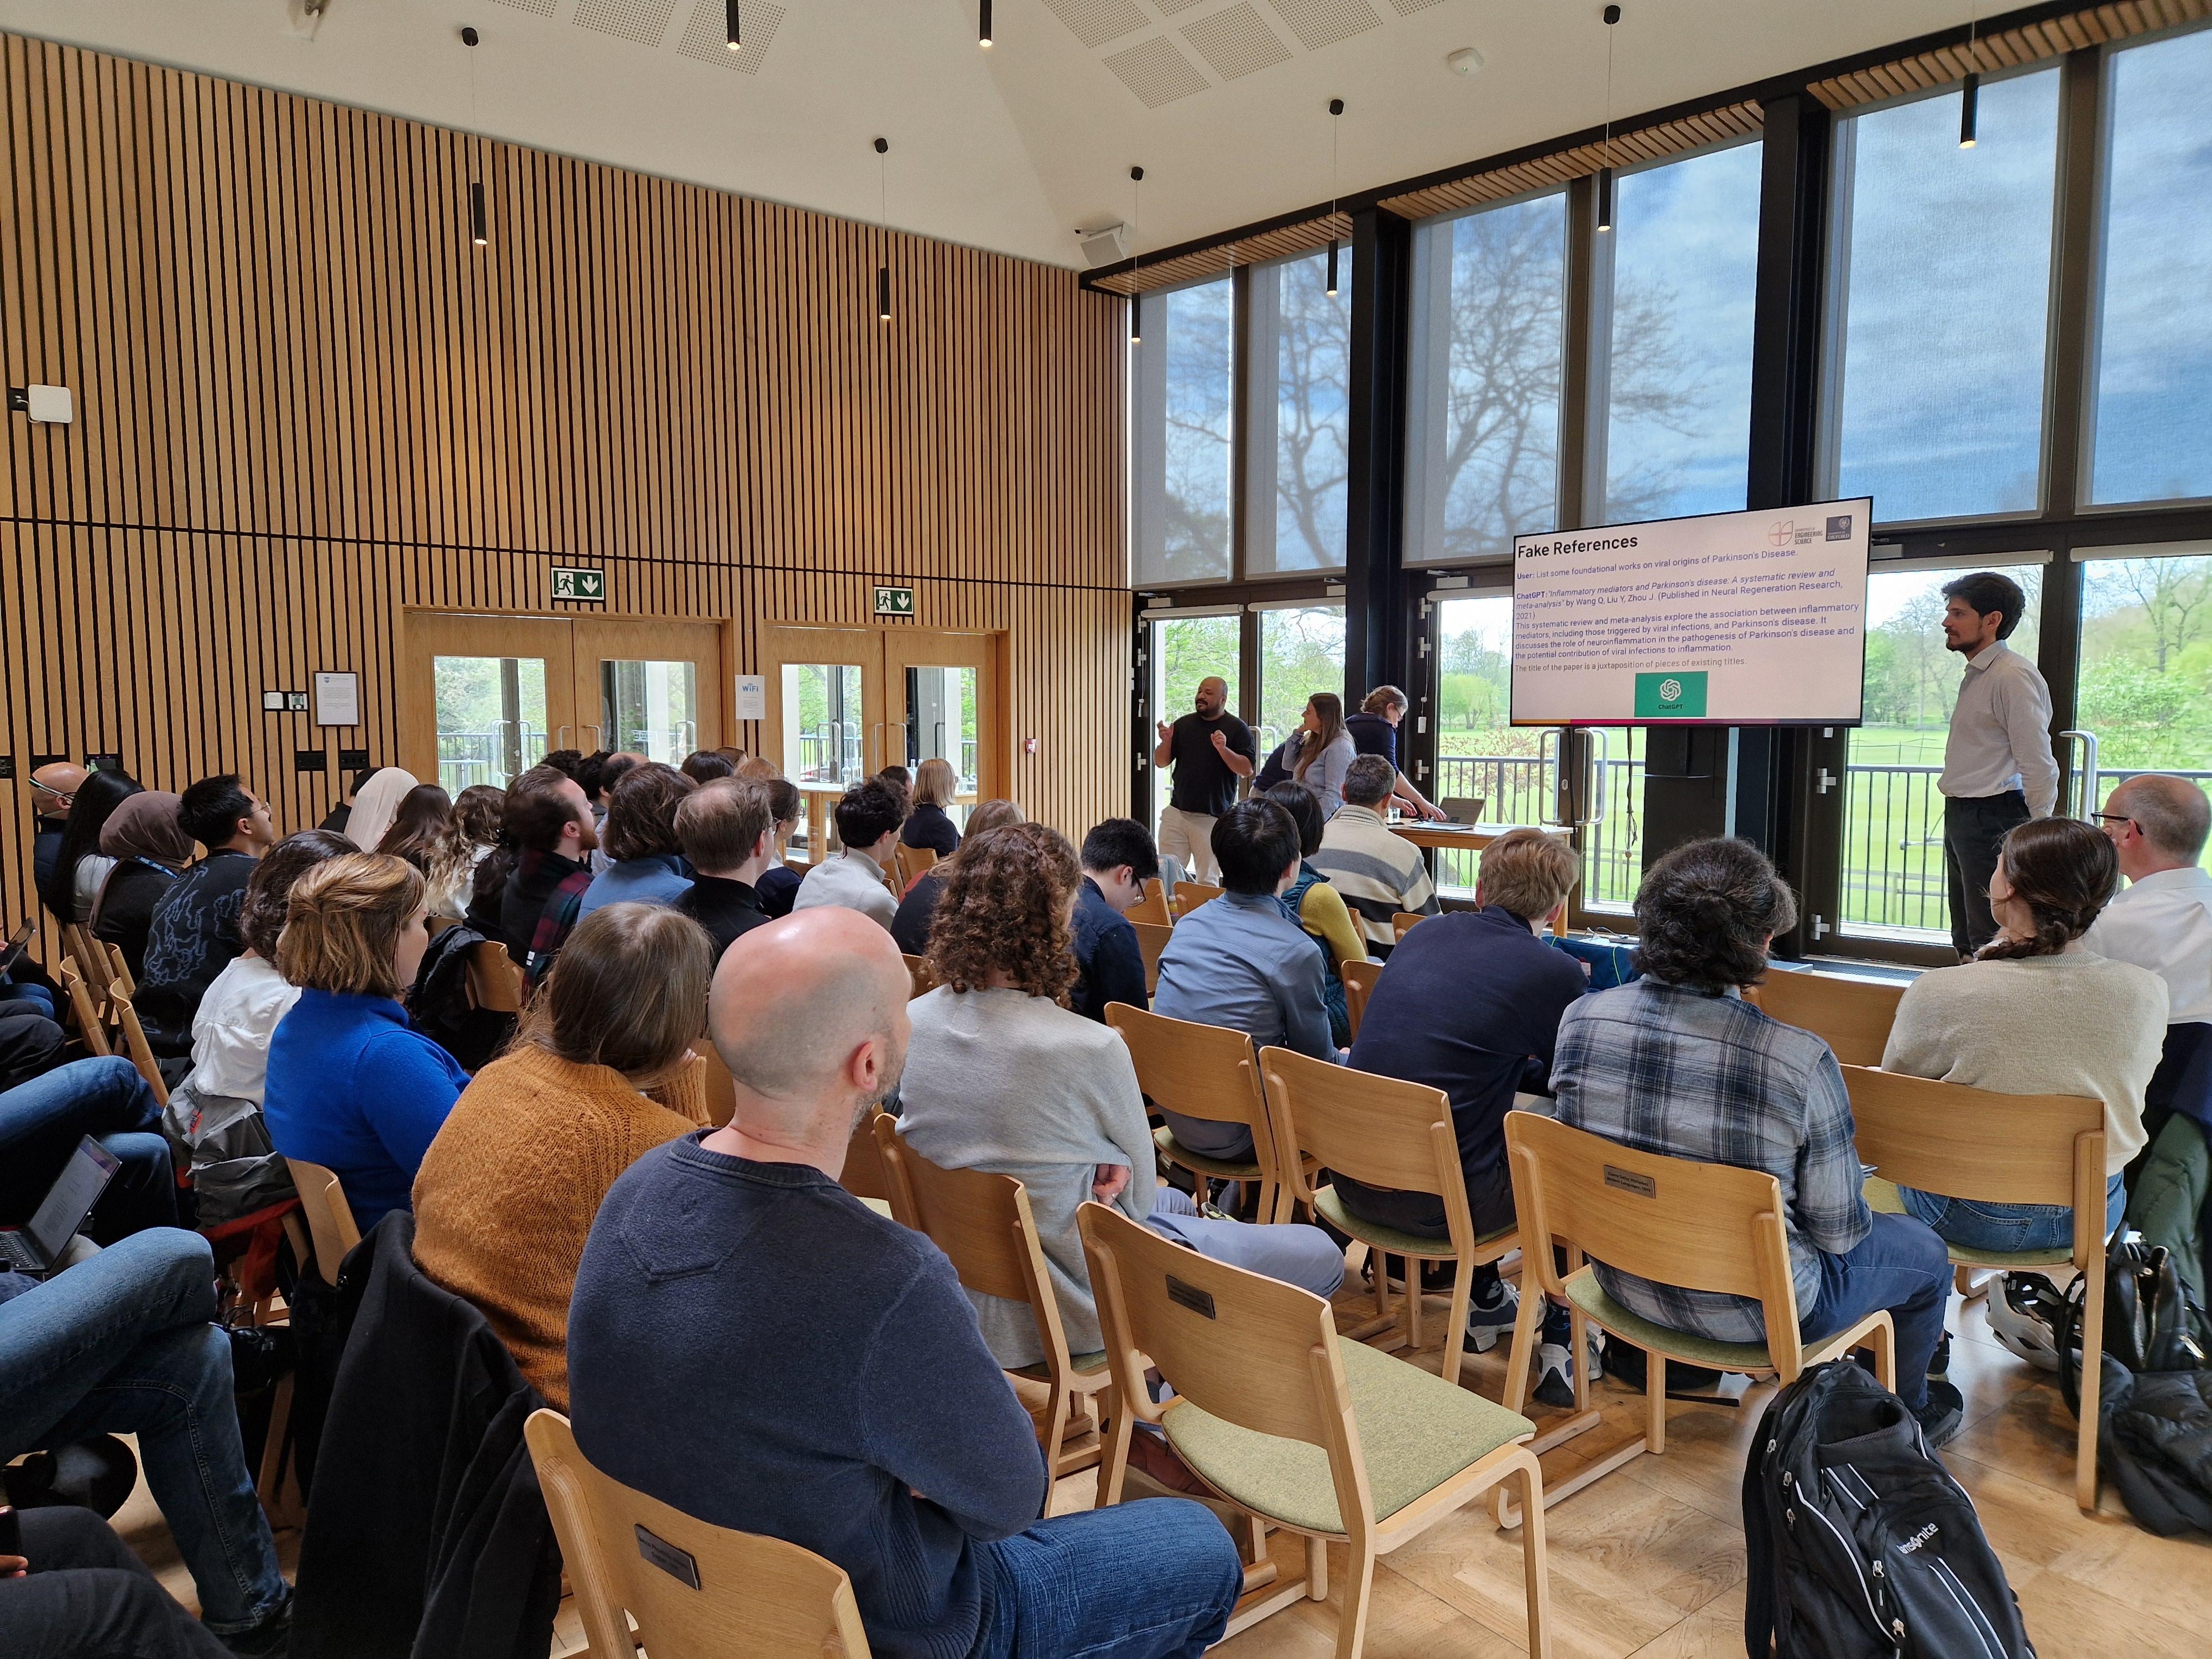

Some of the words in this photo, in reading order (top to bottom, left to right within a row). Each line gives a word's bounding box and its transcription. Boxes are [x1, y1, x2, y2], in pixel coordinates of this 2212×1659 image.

[1519, 544, 1549, 559] Fake
[1554, 536, 1637, 555] References
[1572, 564, 1616, 575] foundational
[1619, 562, 1640, 570] works
[1655, 559, 1670, 567] viral
[1673, 557, 1699, 567] origins
[1702, 555, 1709, 564] of
[1713, 551, 1759, 562] Parkinson's
[1762, 550, 1797, 559] Disease.
[1517, 591, 1547, 599] ChatGPT:
[1651, 580, 1694, 589] Parkinson's
[1740, 573, 1785, 584] systematic
[1788, 571, 1815, 579] review
[1818, 568, 1835, 577] and
[1620, 595, 1625, 603] Y,
[1658, 589, 1699, 601] (Published
[1712, 587, 1737, 596] Neural
[1740, 583, 1796, 594] Regeneration
[1799, 580, 1842, 589] Research,
[1532, 620, 1568, 629] systematic
[1610, 614, 1661, 624] meta-analysis
[1664, 613, 1692, 622] explore
[1710, 609, 1757, 618] association
[1799, 603, 1858, 613] inflammatory
[1607, 626, 1640, 635] triggered
[1642, 625, 1650, 634] by
[1732, 619, 1778, 628] Parkinson's
[1587, 637, 1656, 646] neuroinflammation
[1682, 632, 1735, 643] pathogenesis
[1749, 629, 1797, 638] Parkinson's
[1838, 626, 1854, 634] and
[1527, 650, 1556, 660] potential
[1558, 649, 1600, 657] contribution
[1678, 643, 1733, 652] inflammation.
[1597, 661, 1644, 670] juxtaposition
[1655, 660, 1679, 669] pieces
